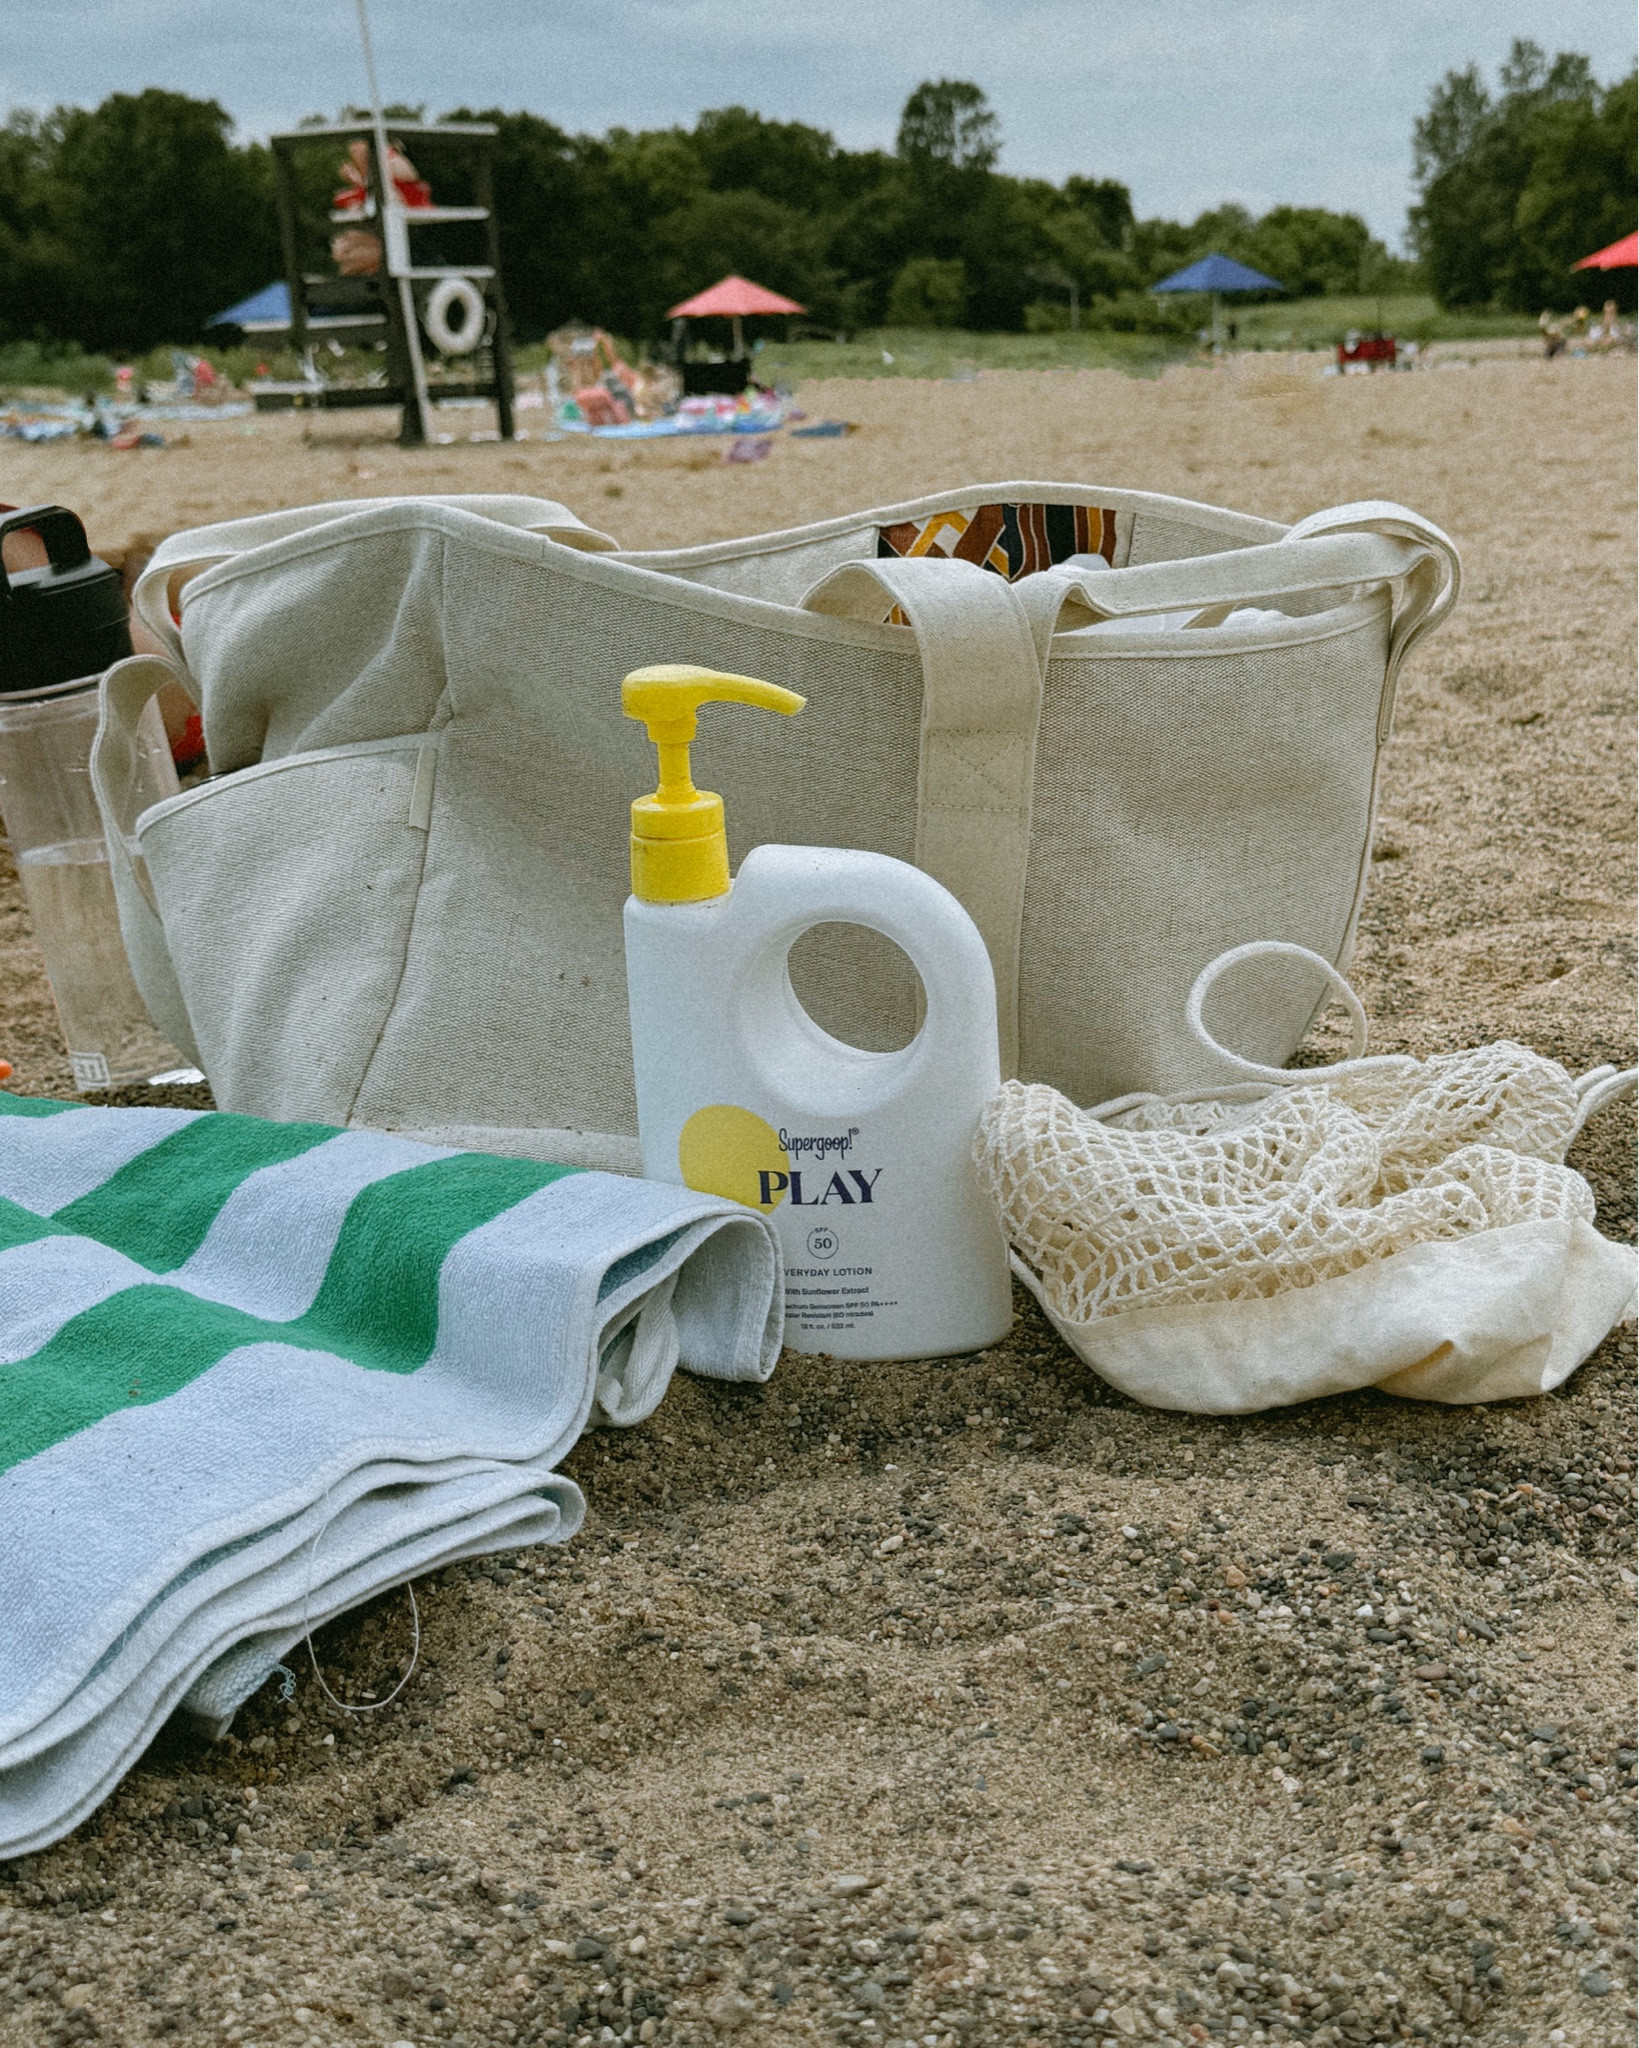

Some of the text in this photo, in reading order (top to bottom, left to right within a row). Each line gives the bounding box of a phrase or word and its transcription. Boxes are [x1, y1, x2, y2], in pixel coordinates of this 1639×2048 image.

[758, 1168, 883, 1205] PLAY
[814, 1237, 832, 1249] 50
[784, 1267, 873, 1277] VERYDAY LOTION
[802, 1287, 840, 1295] Sunflower
[841, 1286, 870, 1295] Extract
[809, 1302, 845, 1310] Sunscreen
[846, 1301, 859, 1309] SPF
[801, 1311, 832, 1319] Resistant
